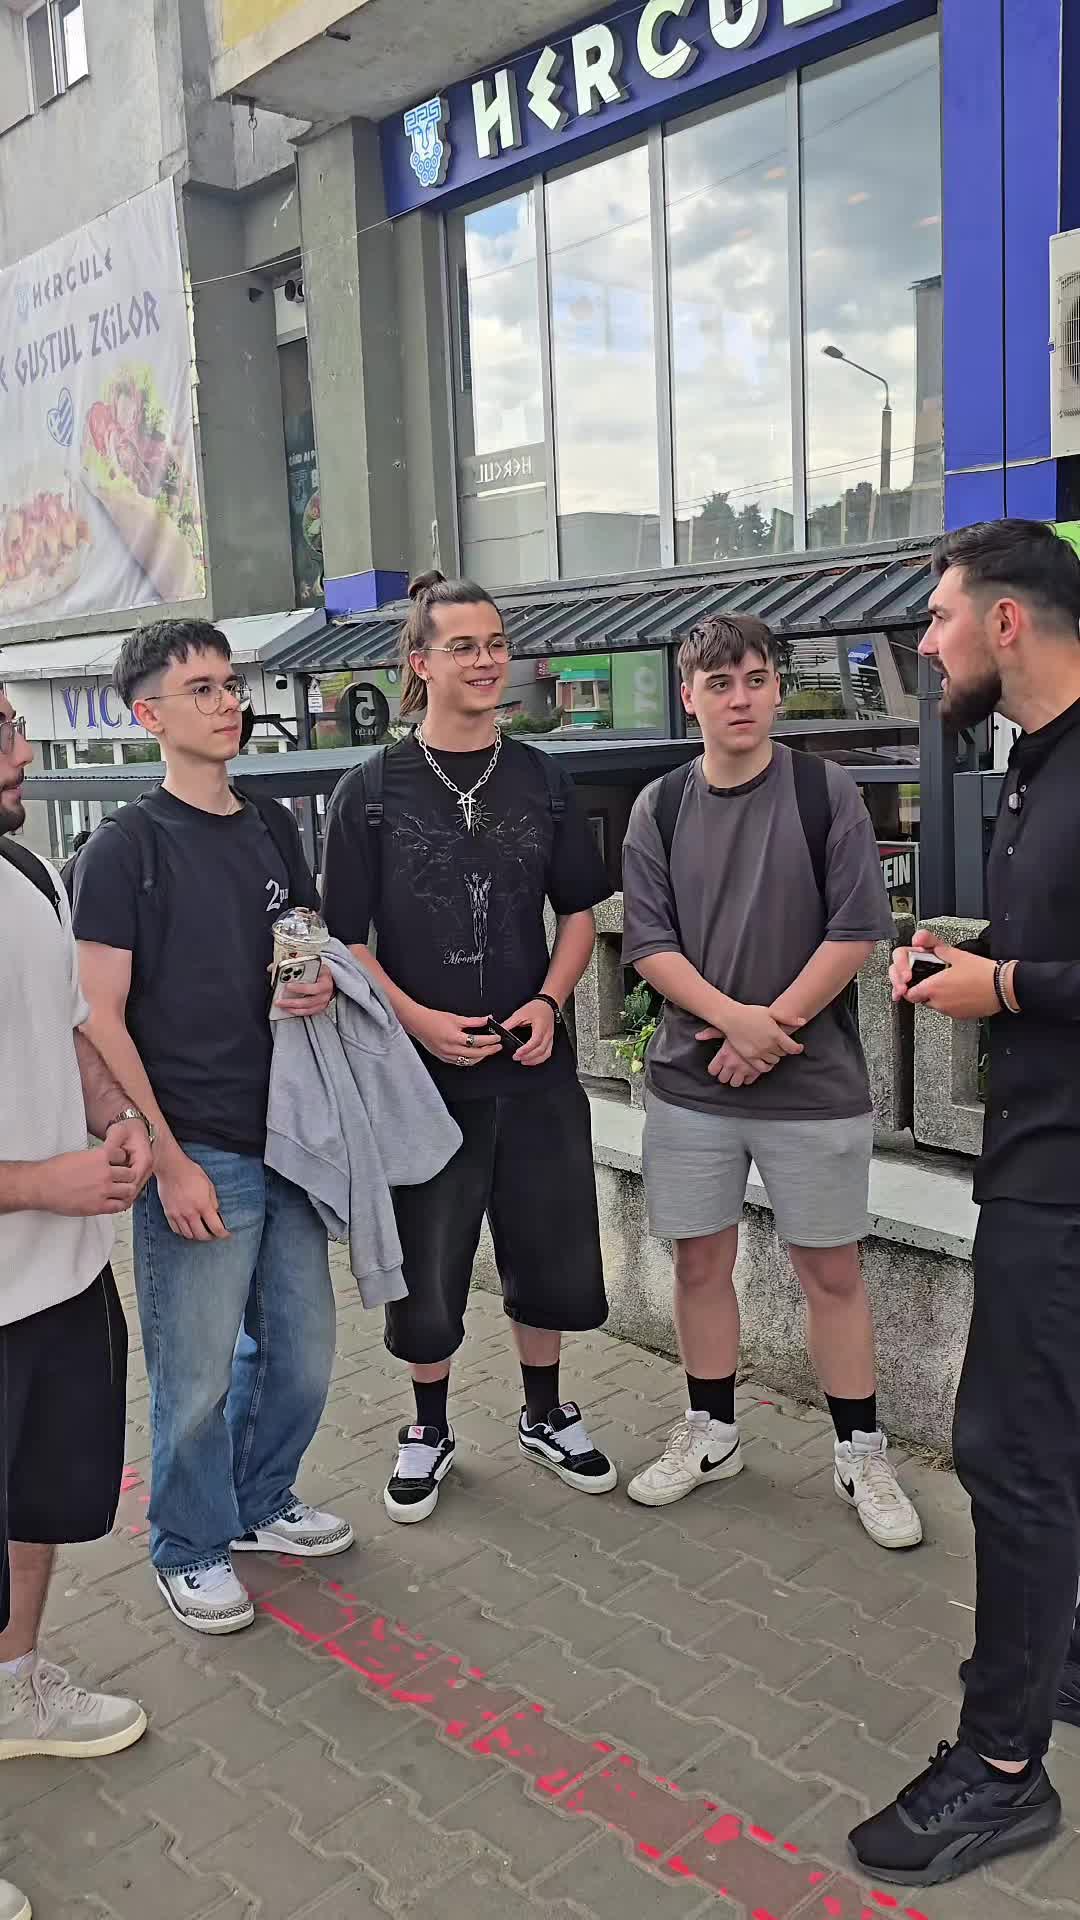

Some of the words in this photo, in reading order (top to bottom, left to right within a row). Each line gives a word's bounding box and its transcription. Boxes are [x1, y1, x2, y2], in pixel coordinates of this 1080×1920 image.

[32, 247, 113, 309] HERCULE
[15, 323, 82, 387] GUSTUL
[60, 685, 142, 729] VIC
[880, 853, 911, 889] EIN
